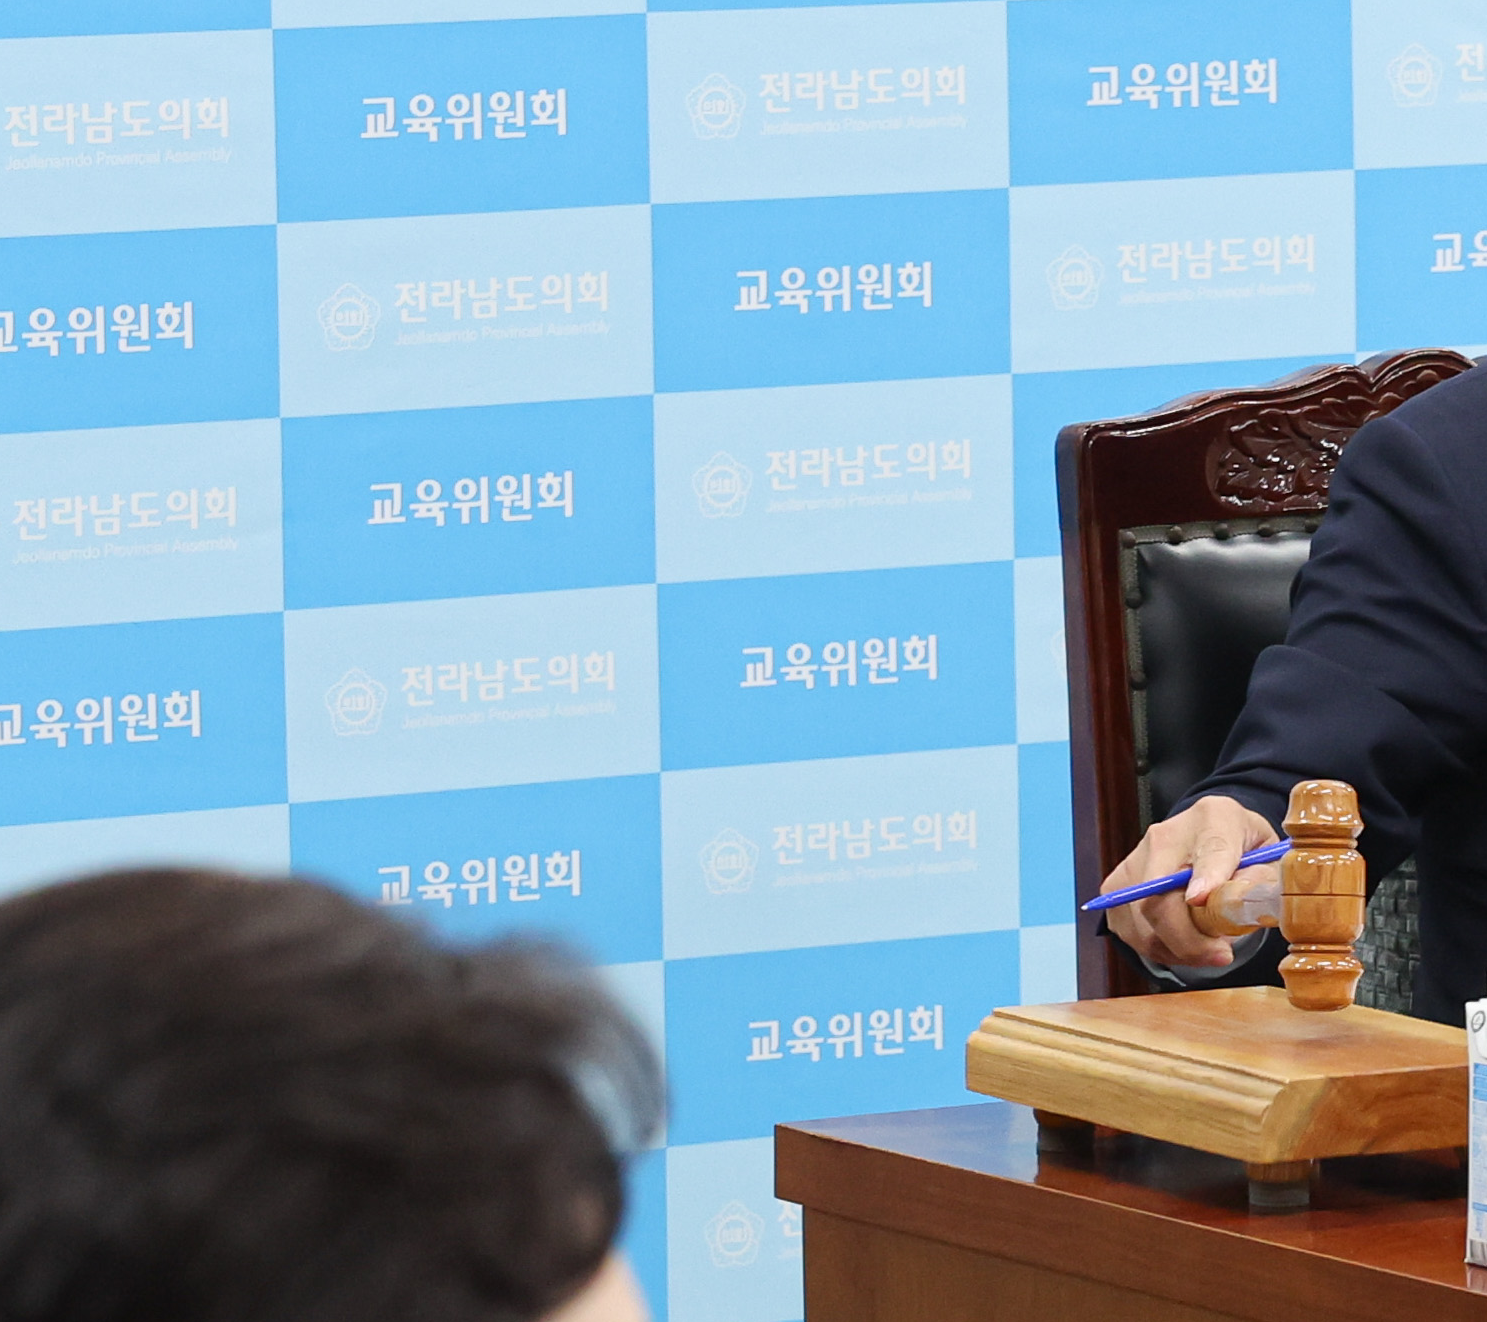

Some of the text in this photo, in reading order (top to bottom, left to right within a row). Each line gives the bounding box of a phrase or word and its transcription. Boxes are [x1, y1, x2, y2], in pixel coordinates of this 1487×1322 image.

[761, 67, 965, 113] 전라남도의회
[1088, 60, 1277, 109] 교육위원회
[6, 99, 229, 147] 전라남도의회
[362, 90, 567, 142] 교육위원회
[1120, 236, 1314, 283] 전라남도의회
[396, 273, 608, 323] 전라남도의회
[736, 263, 932, 314] 교육위원회
[768, 441, 971, 490] 전라남도의회
[14, 488, 236, 541] 전라남도의회
[369, 472, 573, 527] 교육위원회
[403, 653, 615, 707] 전라남도의회
[742, 636, 938, 690] 교육위원회
[775, 812, 977, 865] 전라남도의회
[380, 852, 581, 908] 교육위원회
[748, 1006, 944, 1062] 교육위원회
